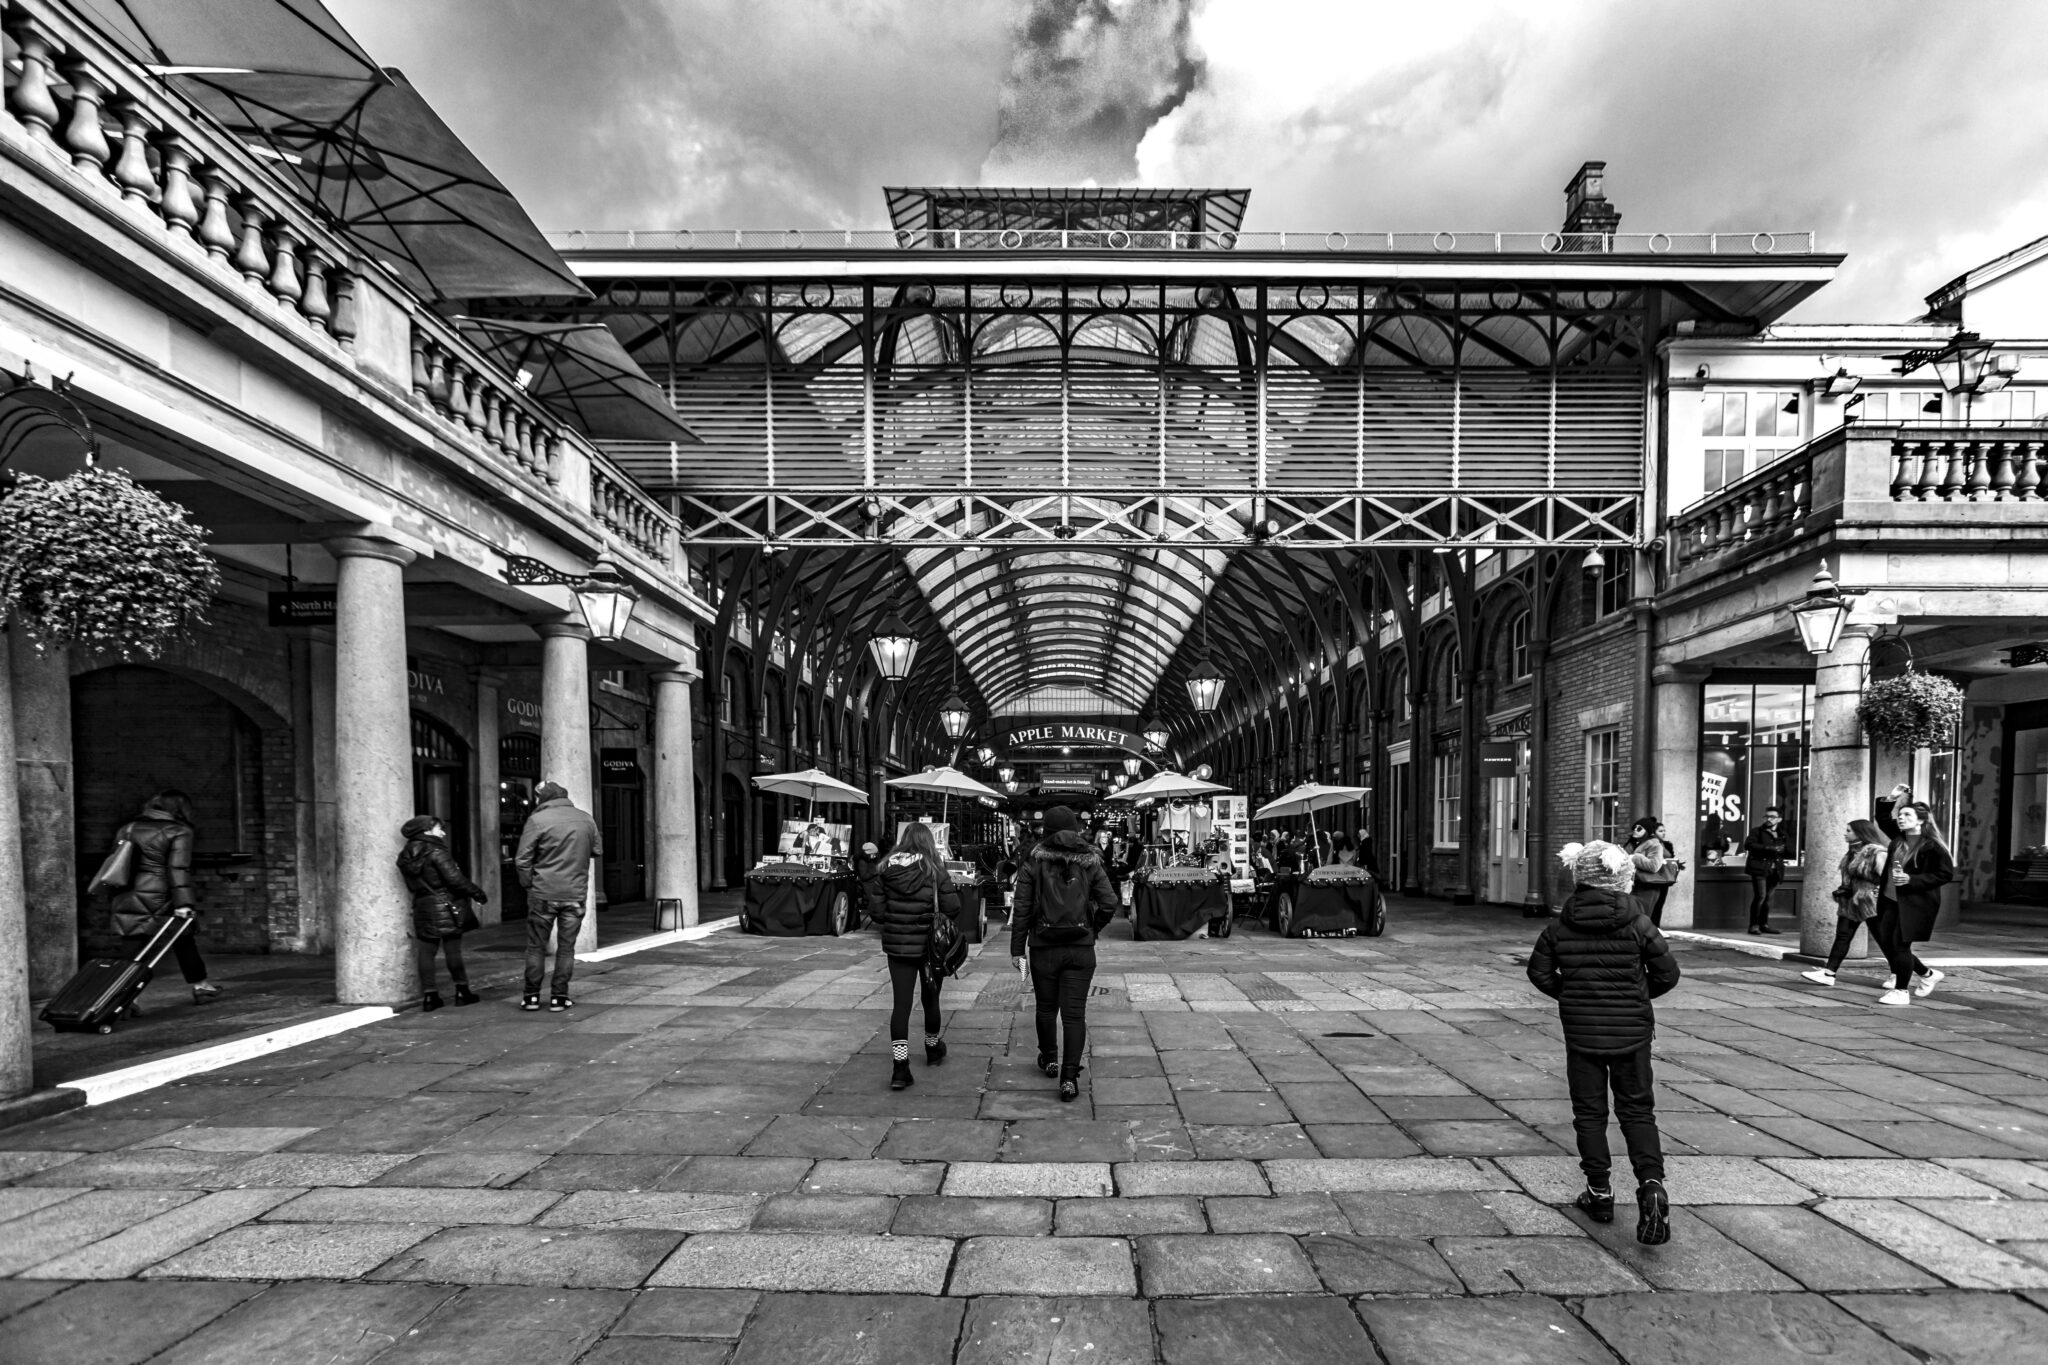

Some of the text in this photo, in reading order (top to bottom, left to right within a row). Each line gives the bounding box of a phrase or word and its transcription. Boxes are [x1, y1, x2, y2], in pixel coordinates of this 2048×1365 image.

[291, 600, 321, 610] North
[1008, 726, 1128, 746] APPLE MARKET
[1707, 777, 1722, 786] BE
